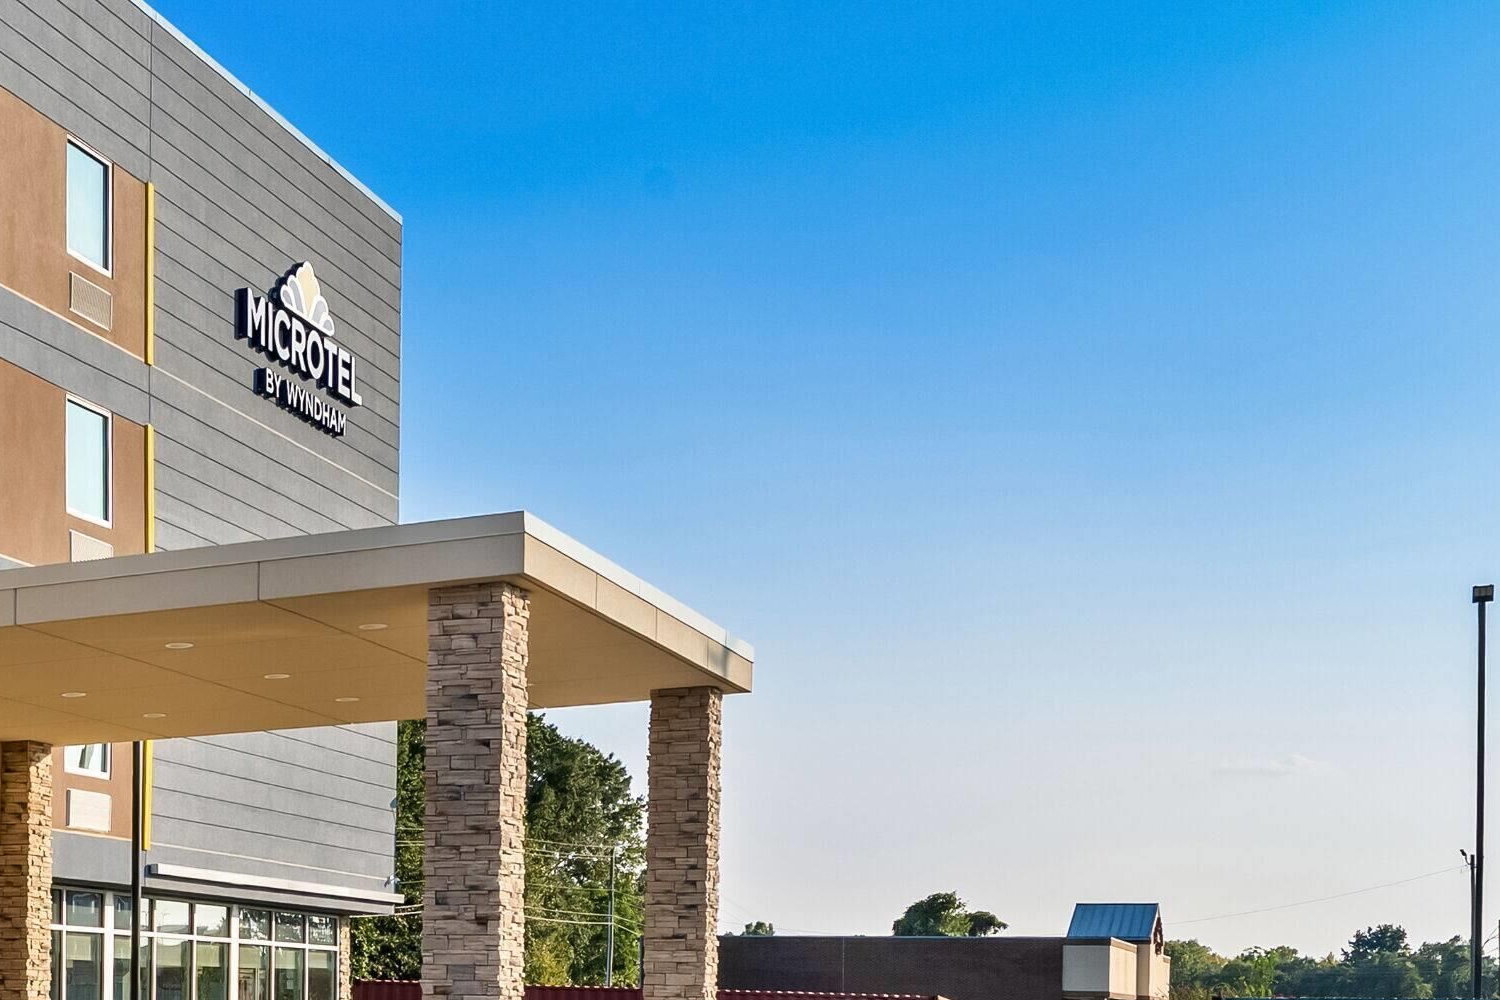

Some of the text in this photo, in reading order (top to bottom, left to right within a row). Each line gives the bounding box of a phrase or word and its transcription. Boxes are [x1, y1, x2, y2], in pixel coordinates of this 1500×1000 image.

[246, 287, 363, 406] MICROTEL
[265, 367, 347, 436] BY WYNDHAM
